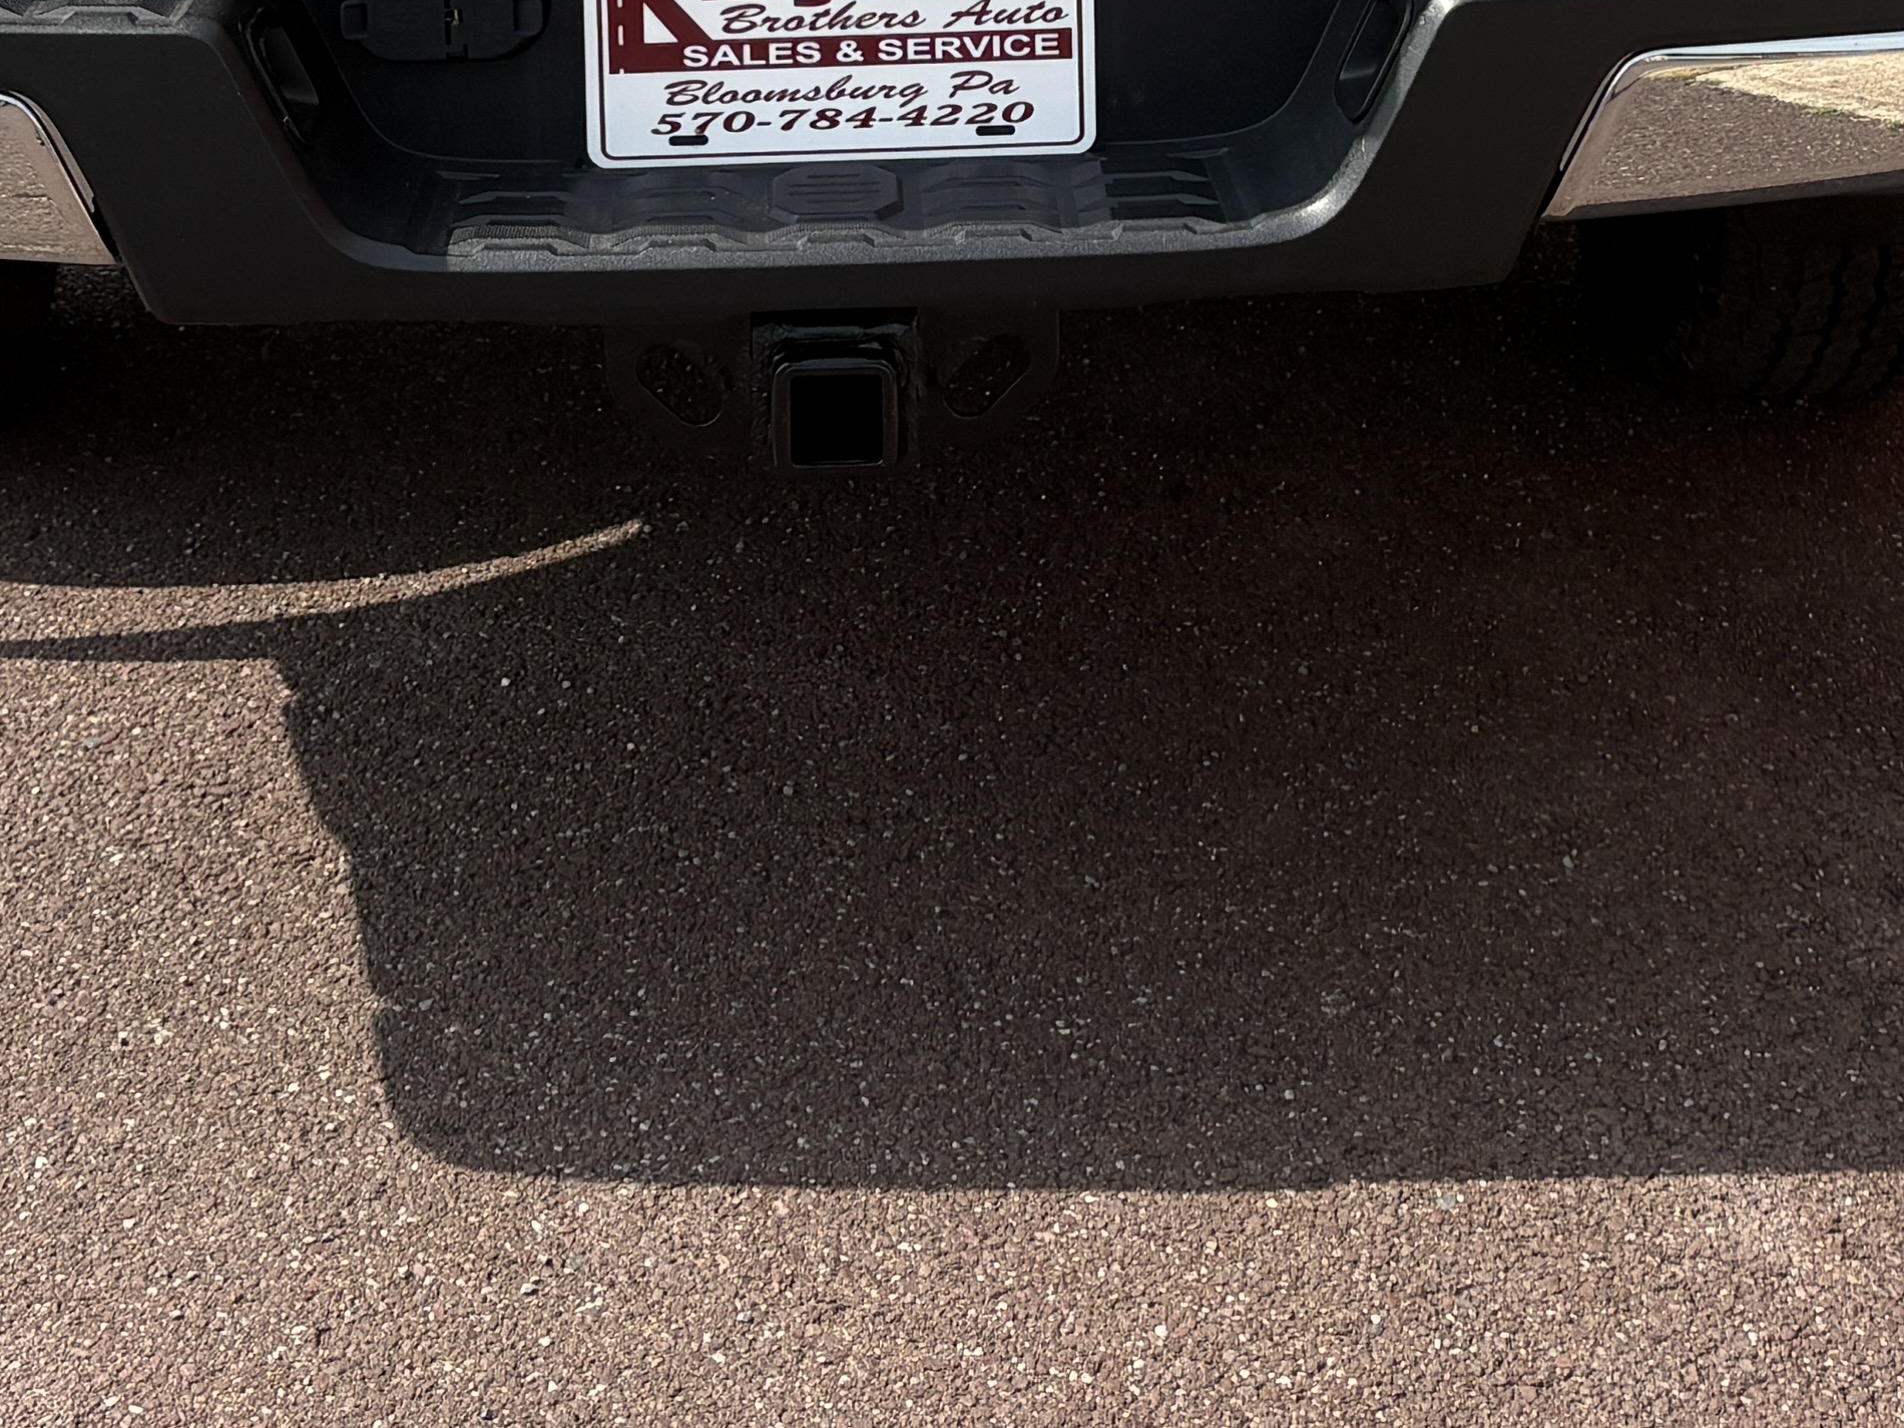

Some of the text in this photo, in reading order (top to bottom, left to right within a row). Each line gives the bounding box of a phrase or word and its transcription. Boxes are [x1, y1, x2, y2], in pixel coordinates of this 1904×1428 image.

[718, 2, 926, 35] Brothers
[682, 34, 1061, 68] SALES & SERVICE
[663, 70, 1020, 109] Bloomsburg Pa
[650, 101, 1036, 137] 570-784-4220
